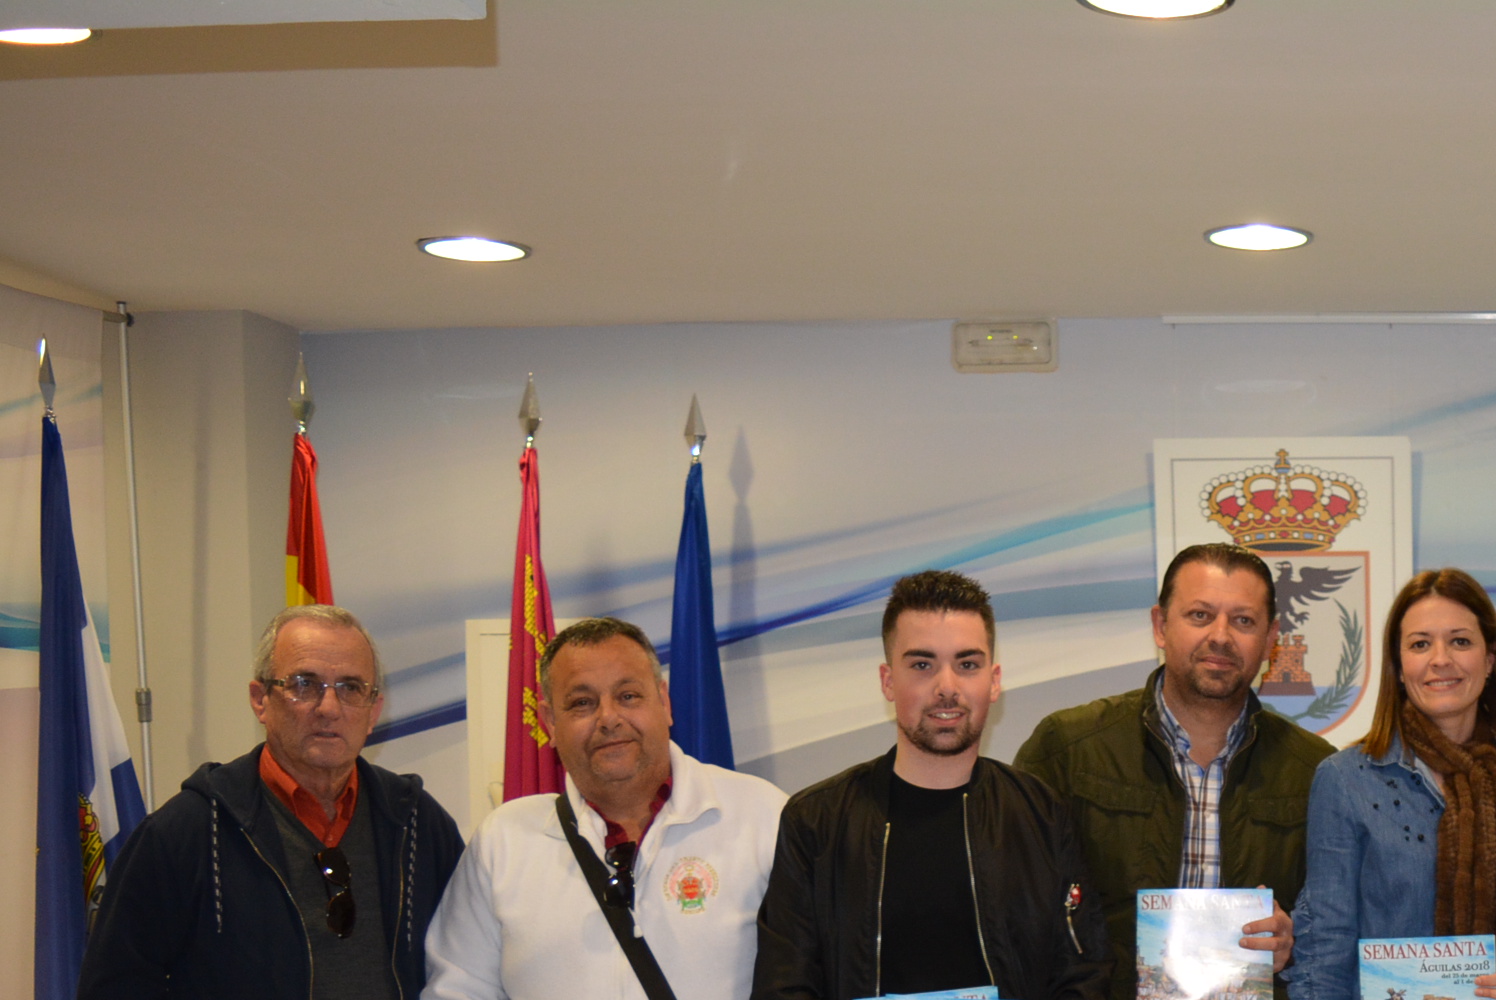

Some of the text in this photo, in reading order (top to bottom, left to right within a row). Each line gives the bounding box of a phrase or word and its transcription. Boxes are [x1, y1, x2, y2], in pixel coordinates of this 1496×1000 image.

[1363, 941, 1487, 960] SEMANA SANTA
[1420, 959, 1490, 973] ÁGUILAS 2018
